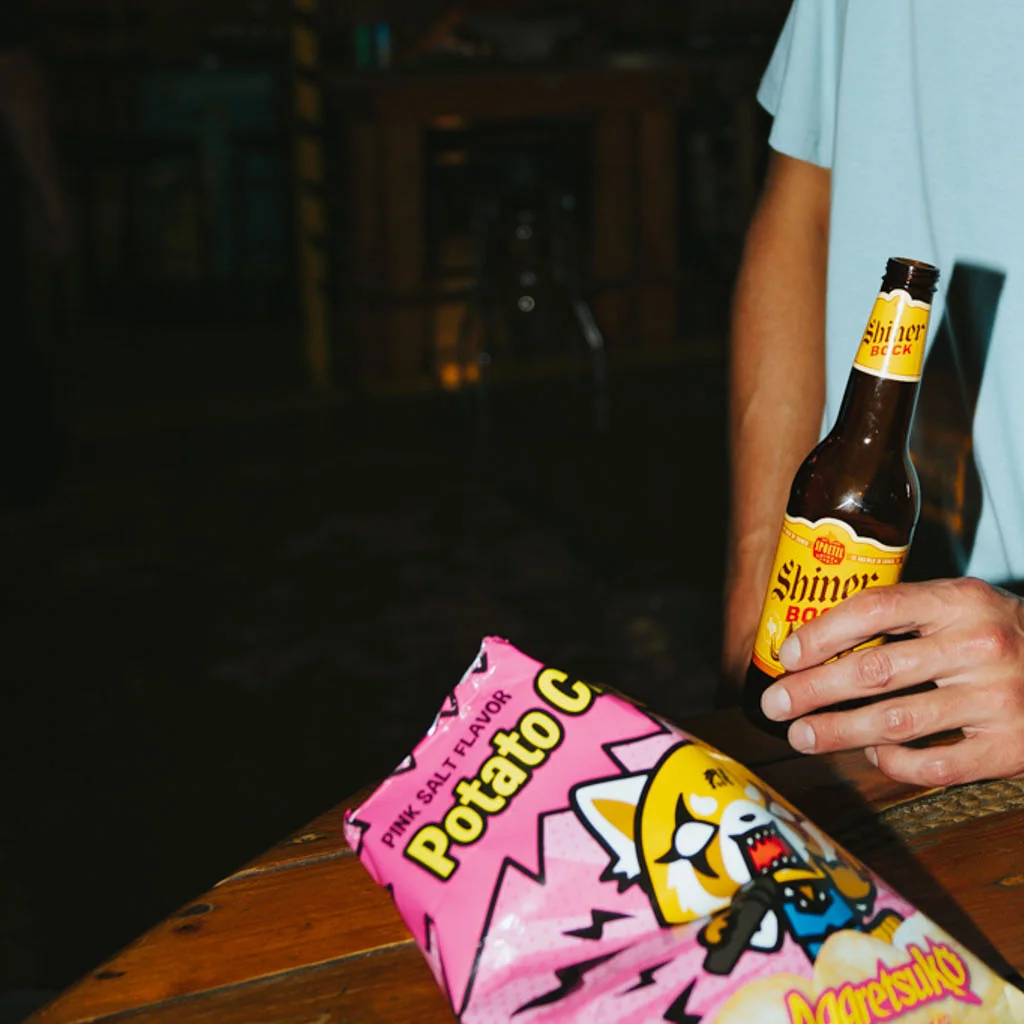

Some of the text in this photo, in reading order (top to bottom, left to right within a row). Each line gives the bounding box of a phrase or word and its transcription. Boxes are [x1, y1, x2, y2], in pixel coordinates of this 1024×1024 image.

[863, 319, 926, 345] Shiner
[870, 343, 912, 357] BOCK
[772, 559, 880, 604] Shiner
[785, 605, 833, 624] BO
[380, 688, 513, 849] PINK SALT FLAVOR
[403, 668, 602, 881] Potato C
